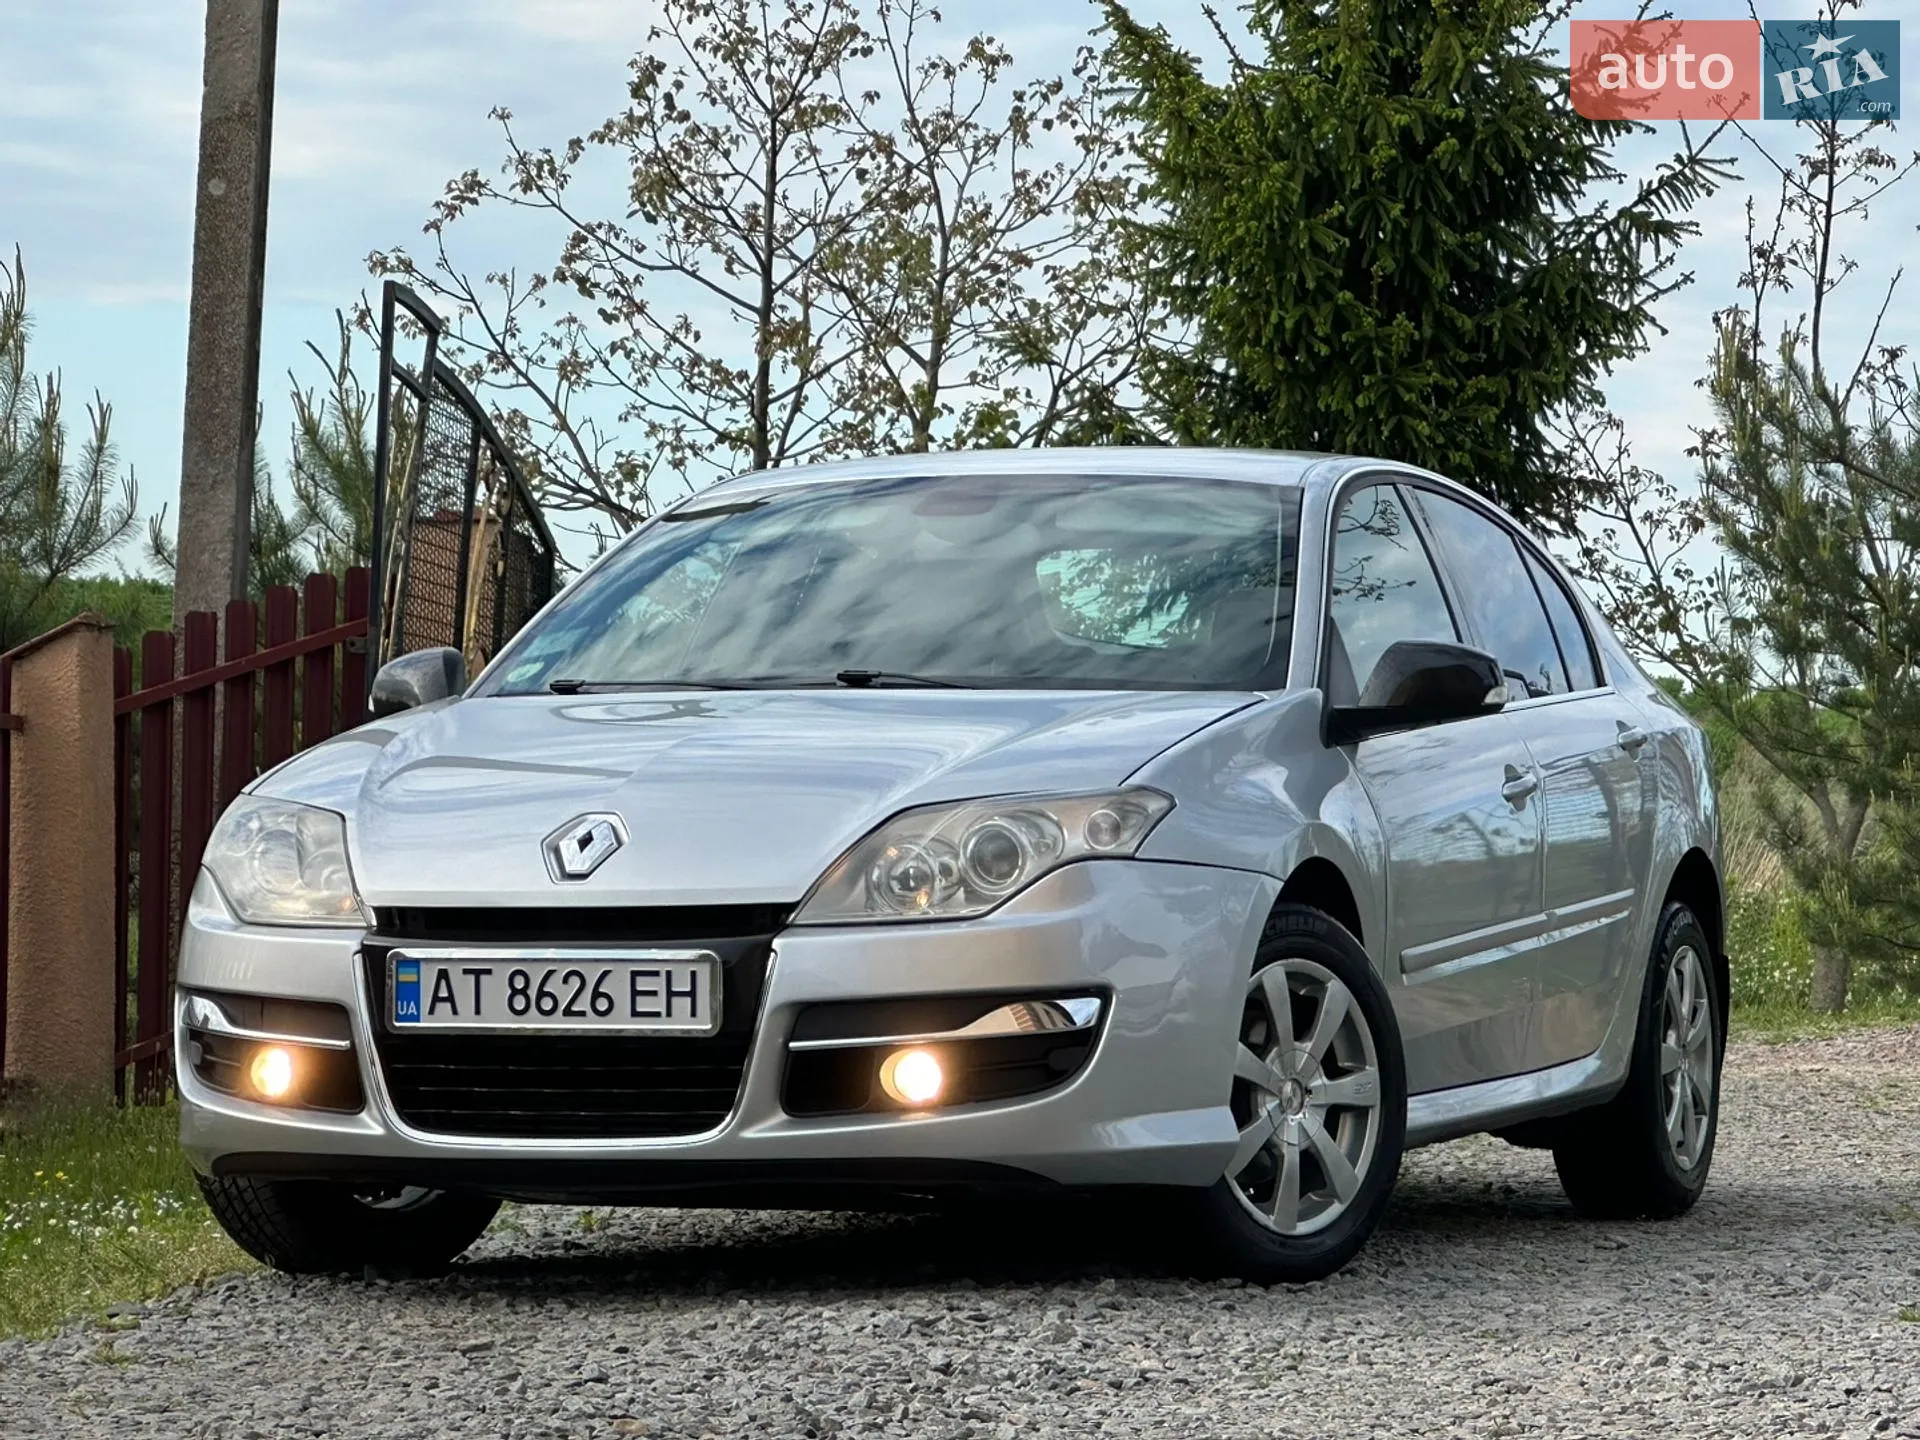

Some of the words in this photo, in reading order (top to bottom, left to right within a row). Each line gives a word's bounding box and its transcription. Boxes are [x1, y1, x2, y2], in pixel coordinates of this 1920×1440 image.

[397, 1001, 418, 1016] UA
[427, 967, 493, 1016] AT
[506, 968, 615, 1017] 8626
[629, 969, 698, 1018] EH
